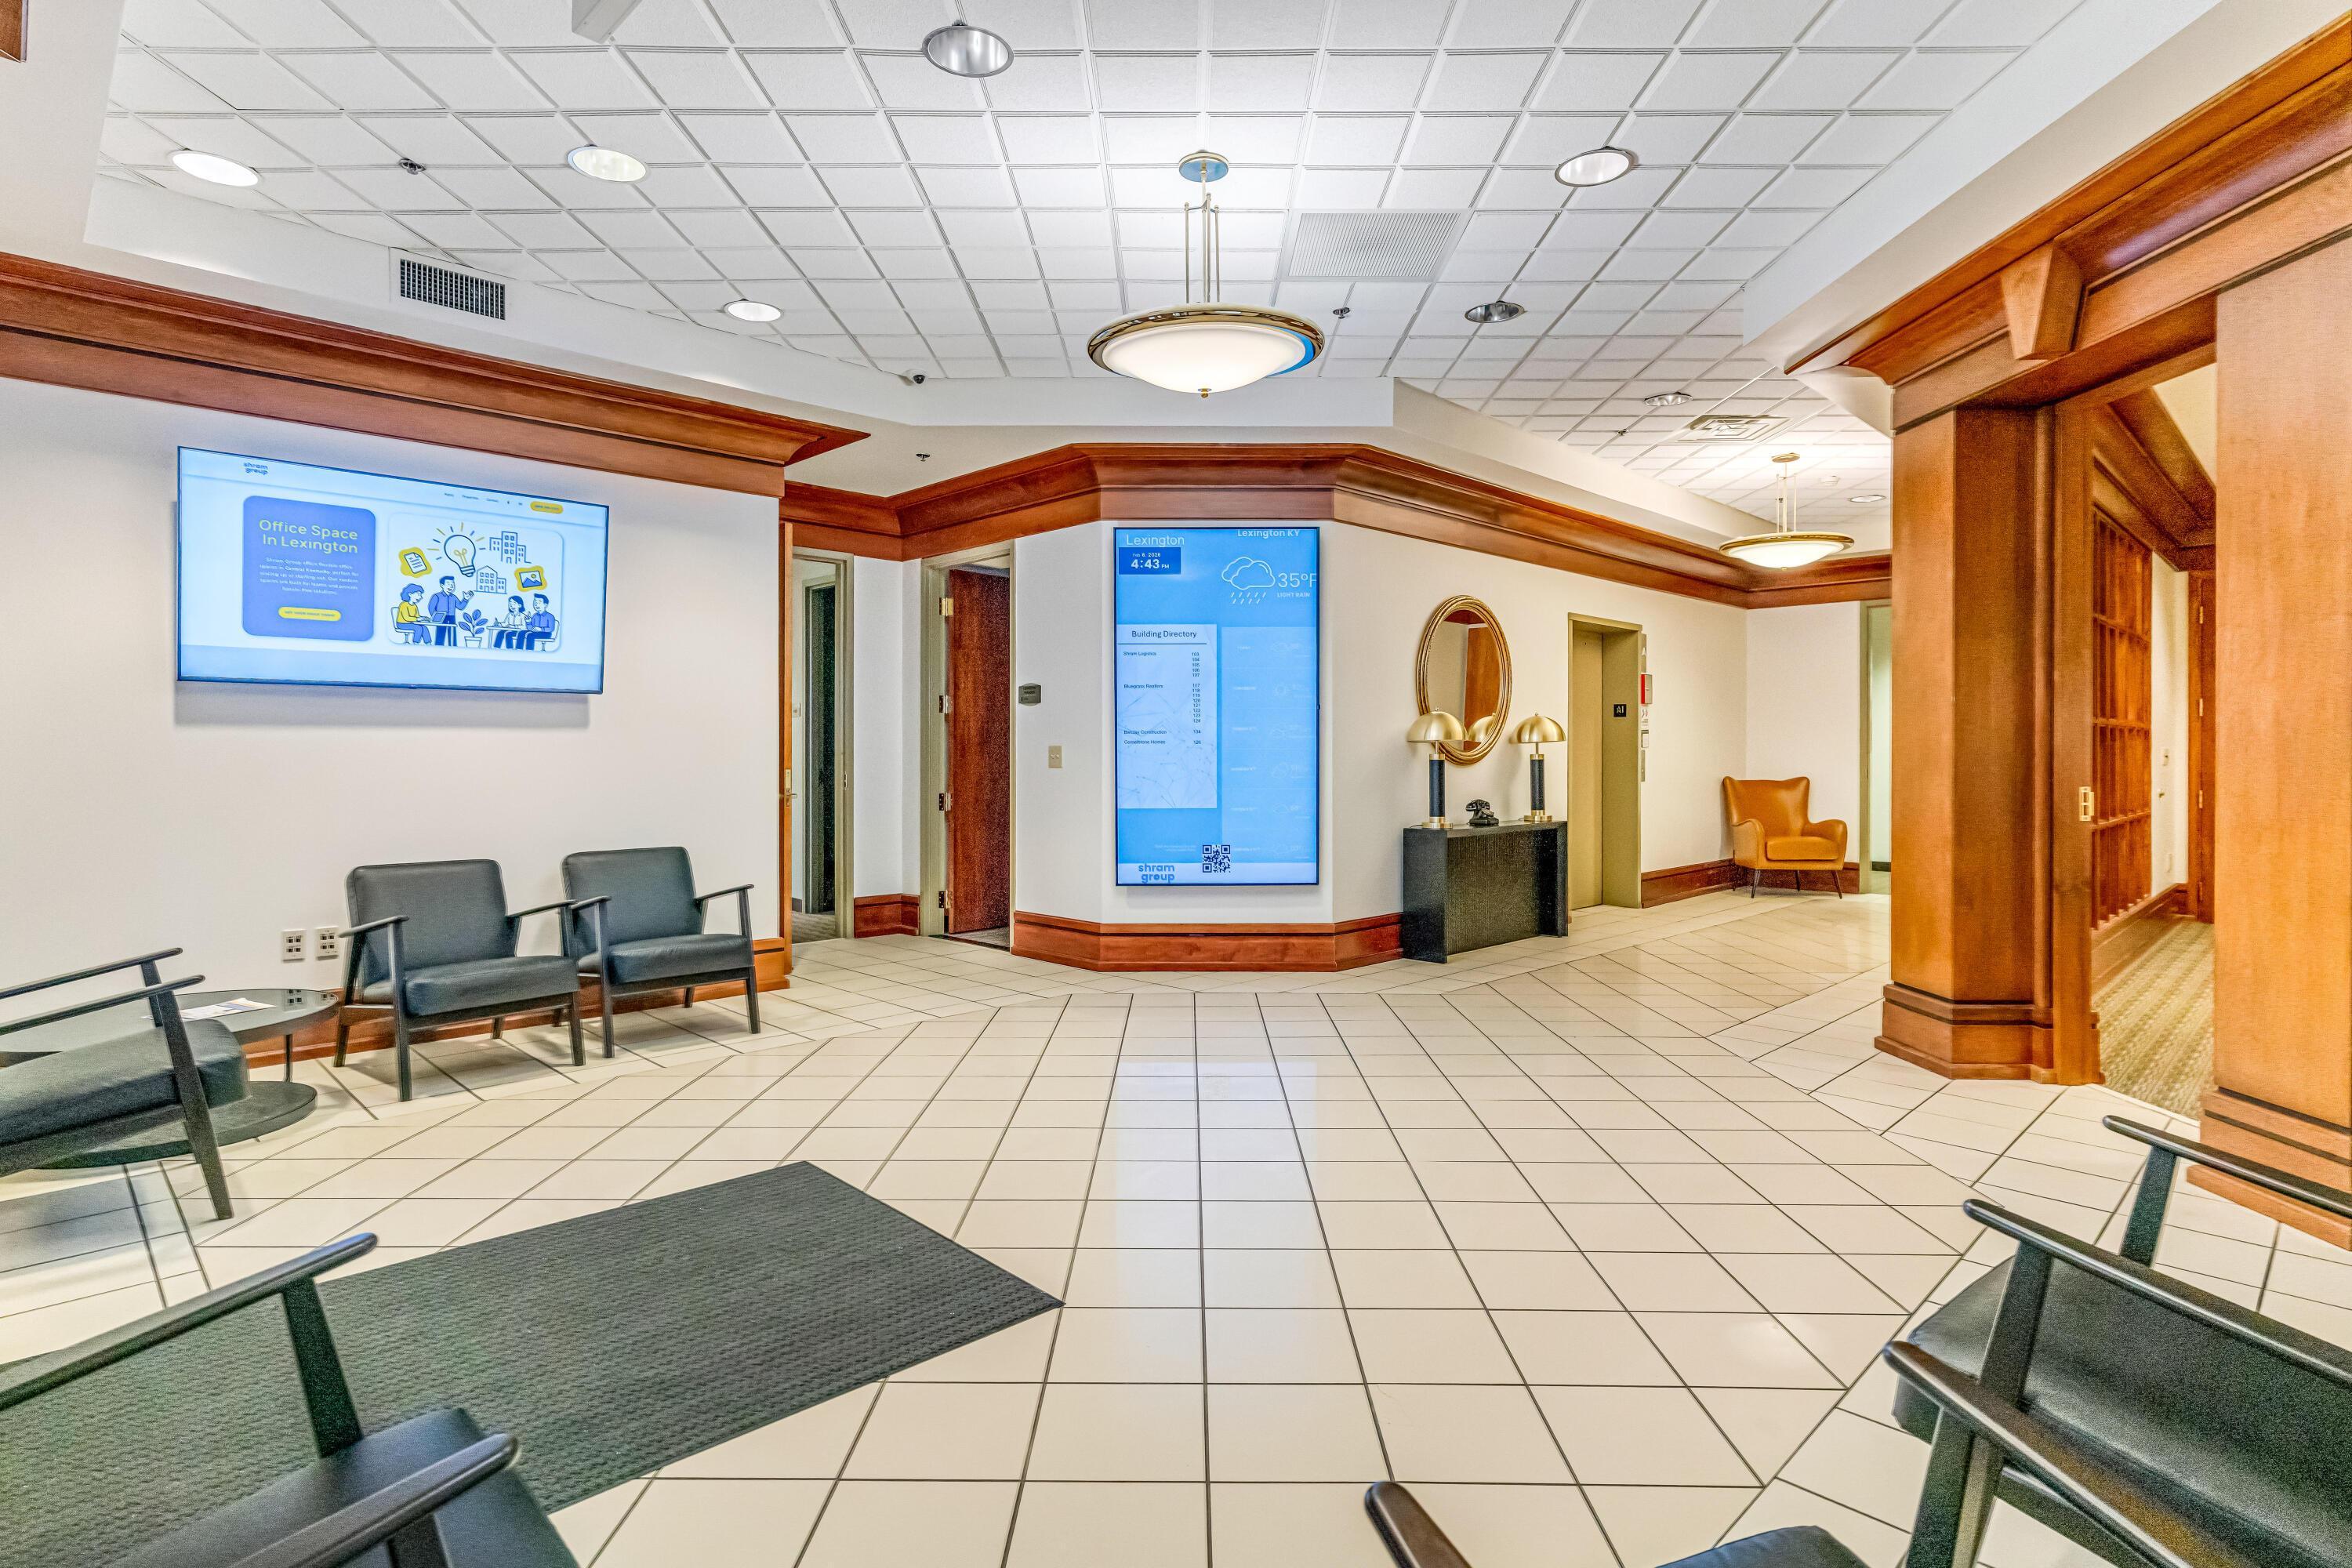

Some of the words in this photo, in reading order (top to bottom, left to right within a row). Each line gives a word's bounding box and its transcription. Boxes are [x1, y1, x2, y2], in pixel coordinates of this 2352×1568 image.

[259, 520, 307, 535] Office
[311, 525, 358, 539] Space
[1238, 529, 1285, 539] Lexington
[263, 534, 277, 546] In
[281, 536, 358, 554] Lexington
[1127, 533, 1185, 547] Lexington
[1131, 558, 1160, 569] 4:43
[1278, 572, 1317, 588] 35°F
[1138, 862, 1174, 872] shram
[1141, 873, 1175, 884] group
